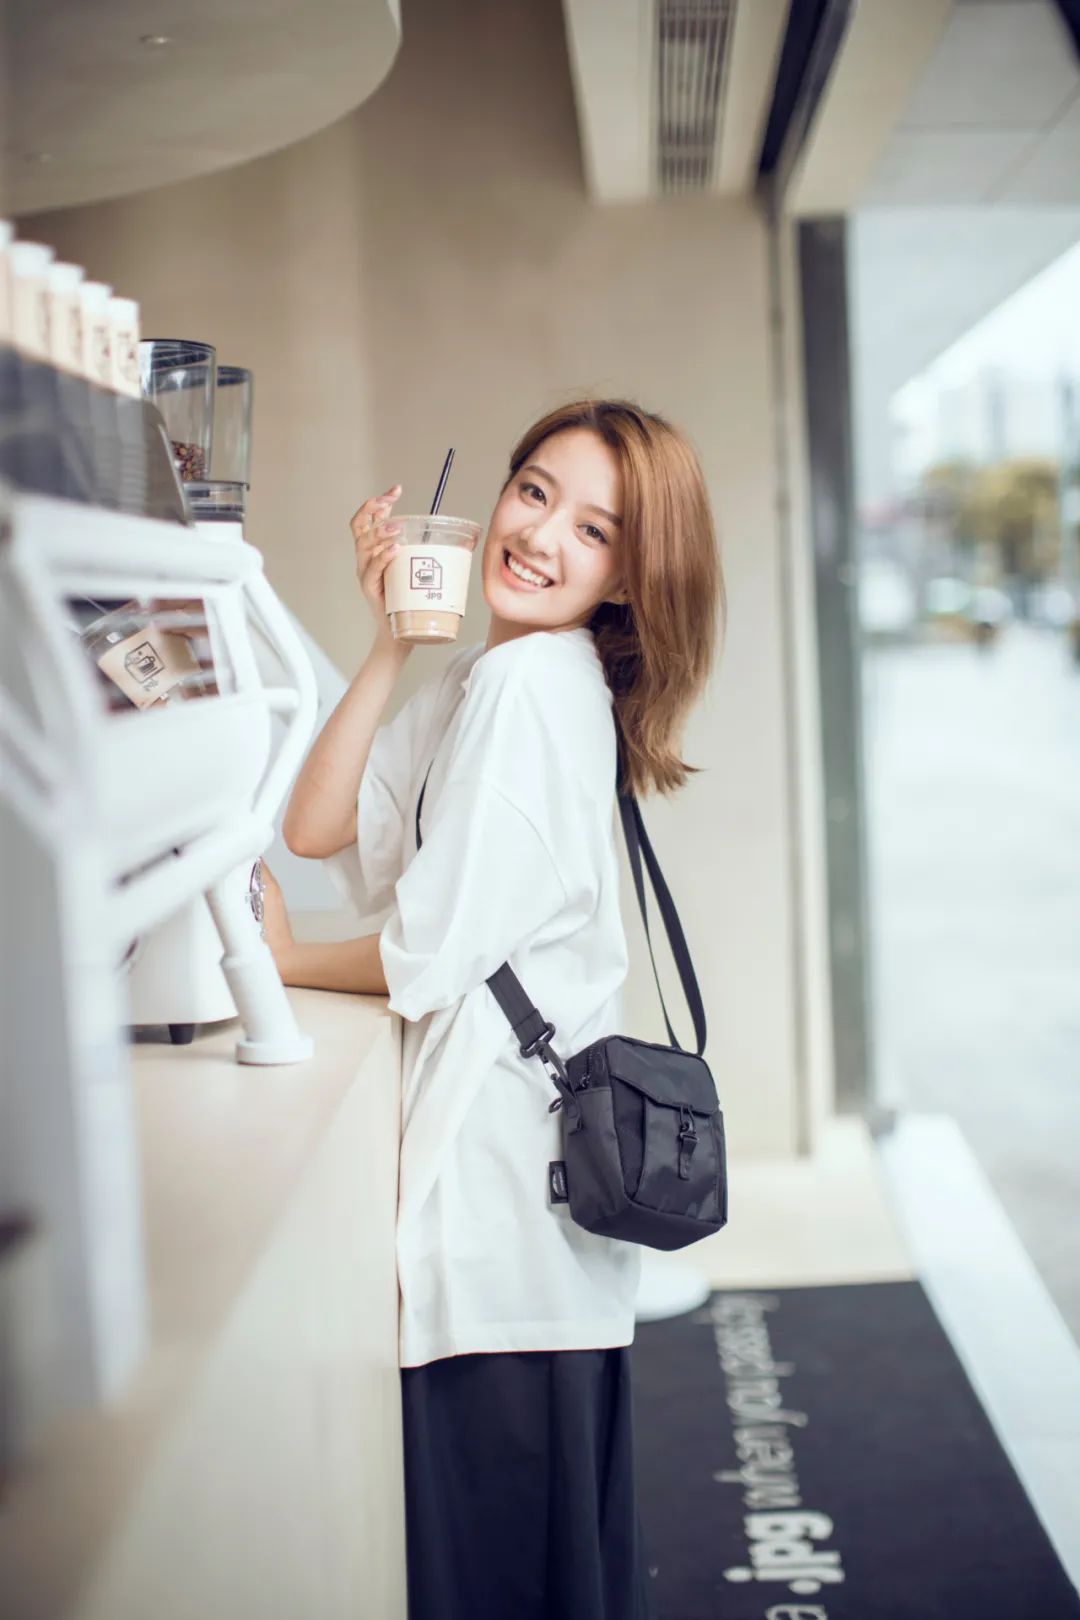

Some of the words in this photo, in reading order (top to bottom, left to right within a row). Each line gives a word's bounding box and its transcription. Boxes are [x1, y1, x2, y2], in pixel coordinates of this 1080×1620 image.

[725, 1377, 808, 1428] you
[713, 1426, 802, 1509] when
[722, 1510, 845, 1595] .jpg
